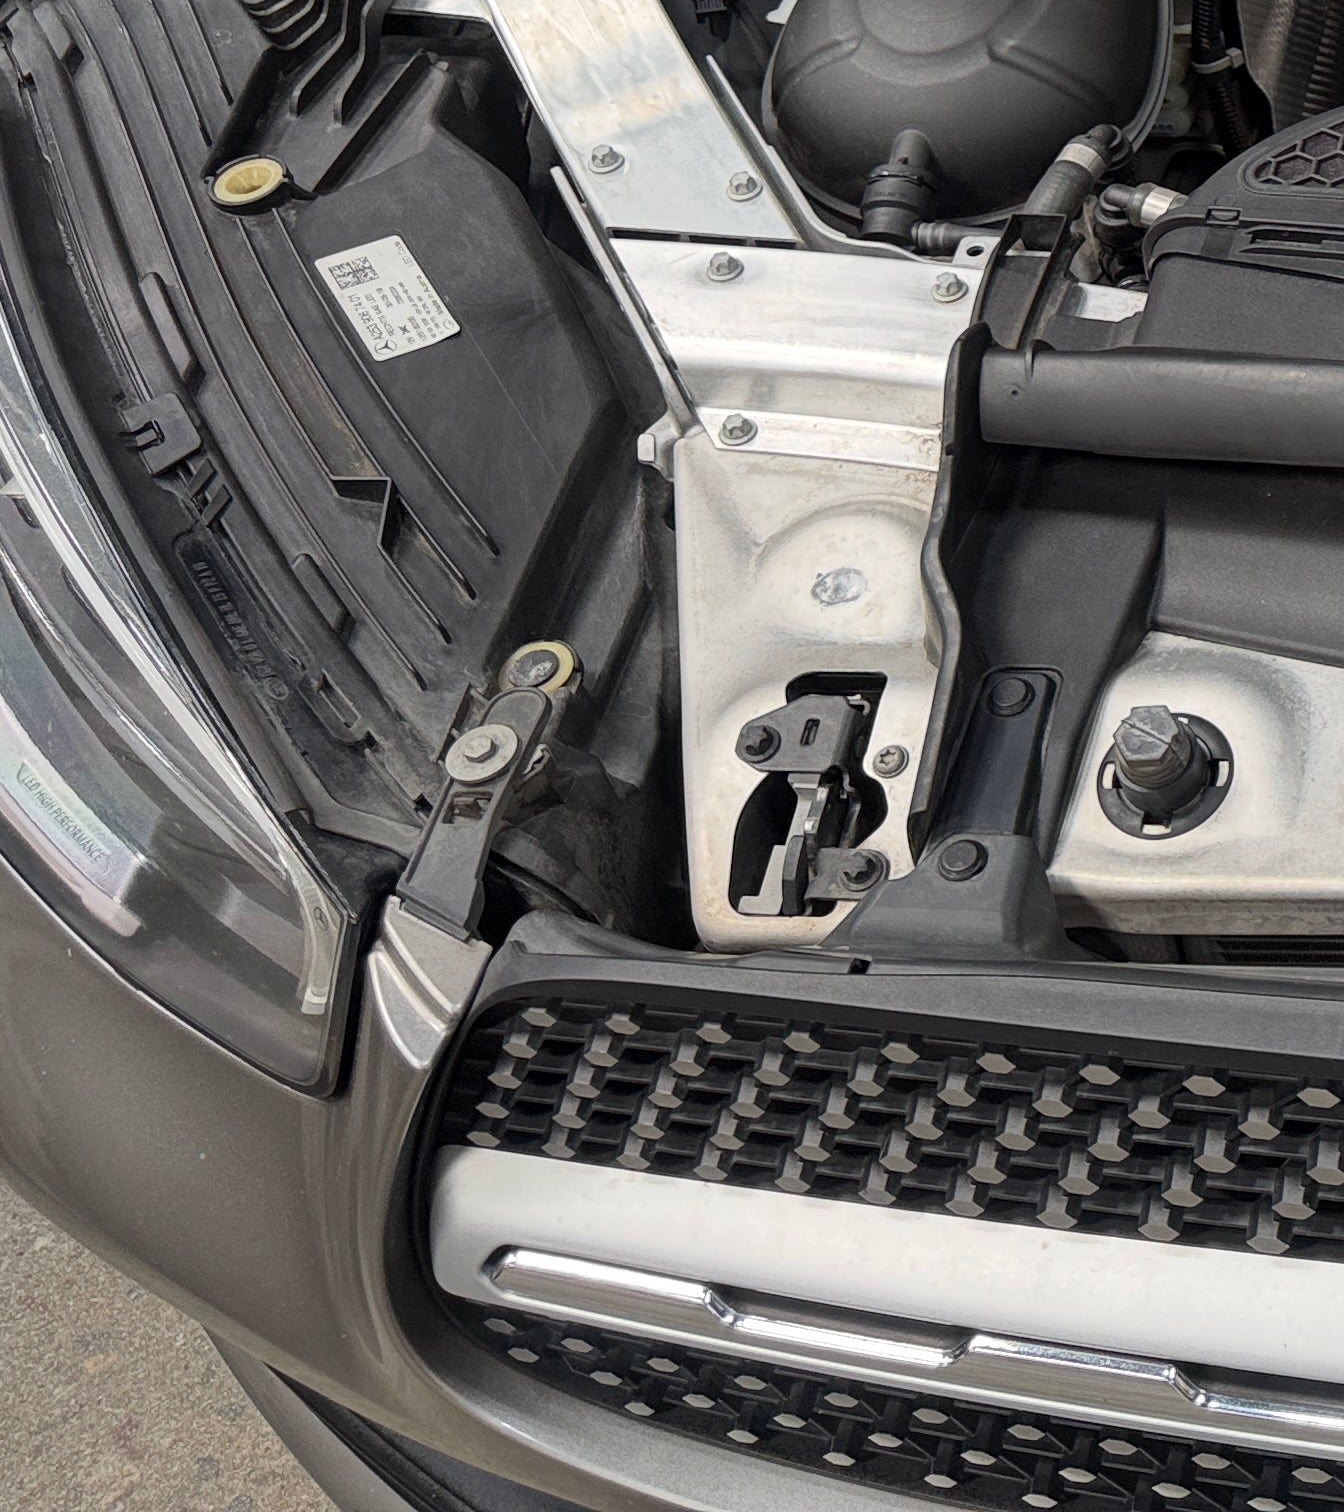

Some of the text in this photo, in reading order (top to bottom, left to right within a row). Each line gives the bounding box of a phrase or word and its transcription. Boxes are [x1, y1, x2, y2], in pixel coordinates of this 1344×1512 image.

[21, 773, 105, 863] LED HIGH PERFORMANCE
